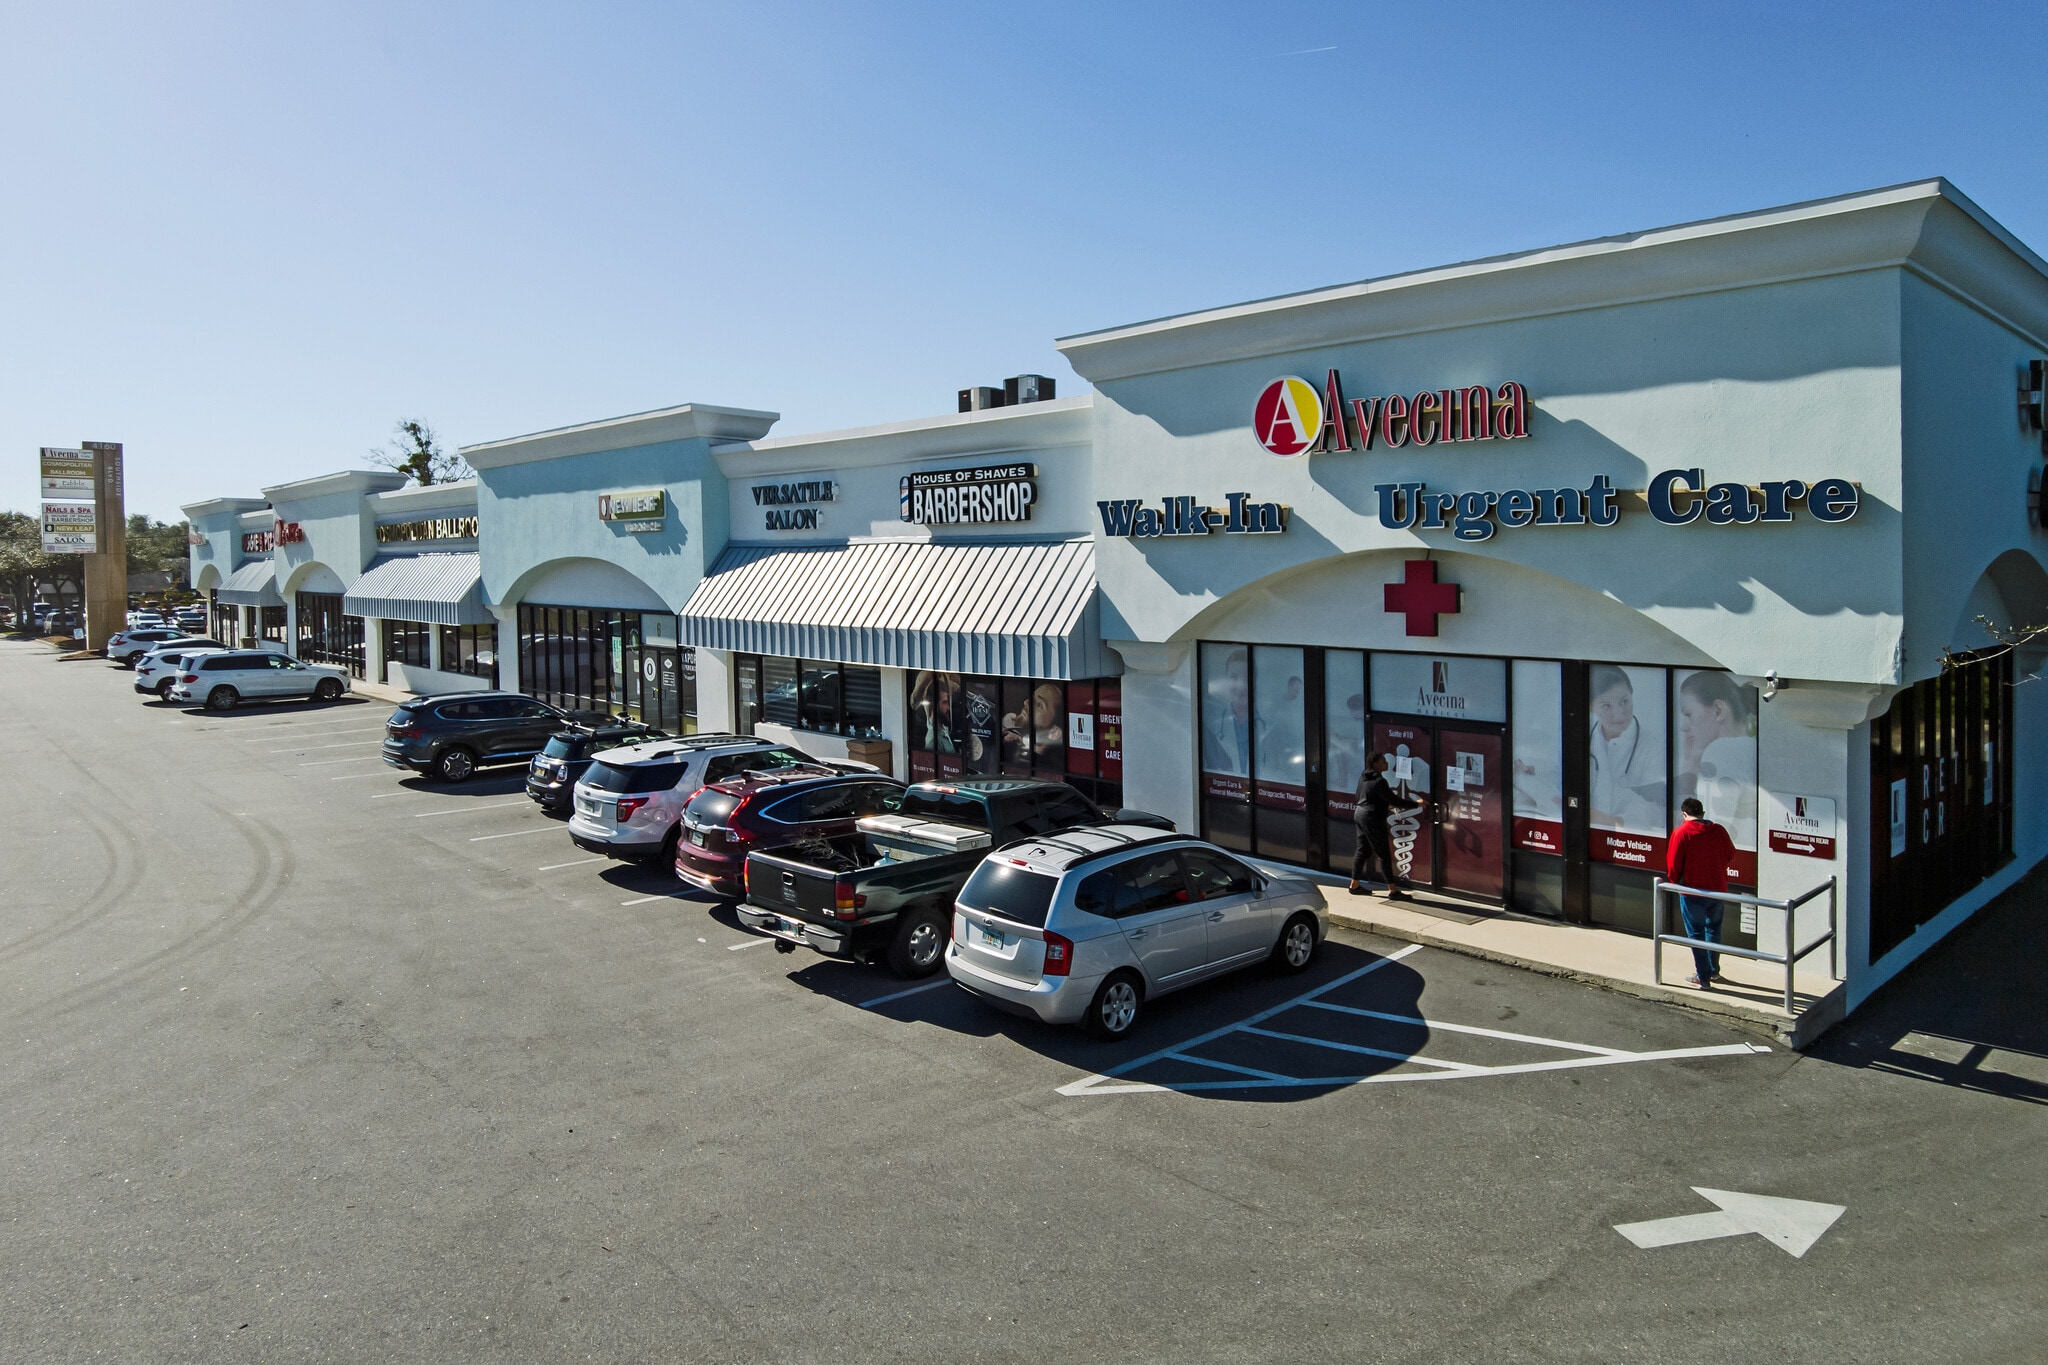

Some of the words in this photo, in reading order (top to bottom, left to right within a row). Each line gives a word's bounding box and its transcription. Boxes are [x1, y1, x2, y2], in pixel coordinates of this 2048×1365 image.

[1313, 368, 1529, 454] Avecina
[914, 474, 952, 484] HOUSE
[956, 472, 972, 481] OF
[975, 467, 1026, 479] SHAVES
[752, 481, 834, 505] VERSATILE
[914, 482, 1032, 524] BARBERSHOP
[1374, 474, 1620, 542] Urgent
[1646, 468, 1860, 526] Care
[766, 508, 818, 530] SALON
[1097, 491, 1287, 538] Walk-In
[436, 516, 479, 539] BALLROO
[1417, 686, 1465, 709] Avecina
[1389, 729, 1402, 737] Suite
[1403, 730, 1413, 740] #10
[1105, 750, 1121, 760] CARE
[1258, 788, 1286, 799] Chiropractic
[1286, 793, 1304, 803] Therapy
[1329, 800, 1349, 809] Physical
[1784, 812, 1819, 828] Avecina
[1607, 837, 1626, 848] Motor
[1627, 840, 1652, 851] Vehicle
[1788, 834, 1809, 842] PARKING
[1613, 850, 1646, 862] Accidents
[1726, 866, 1739, 877] ion
